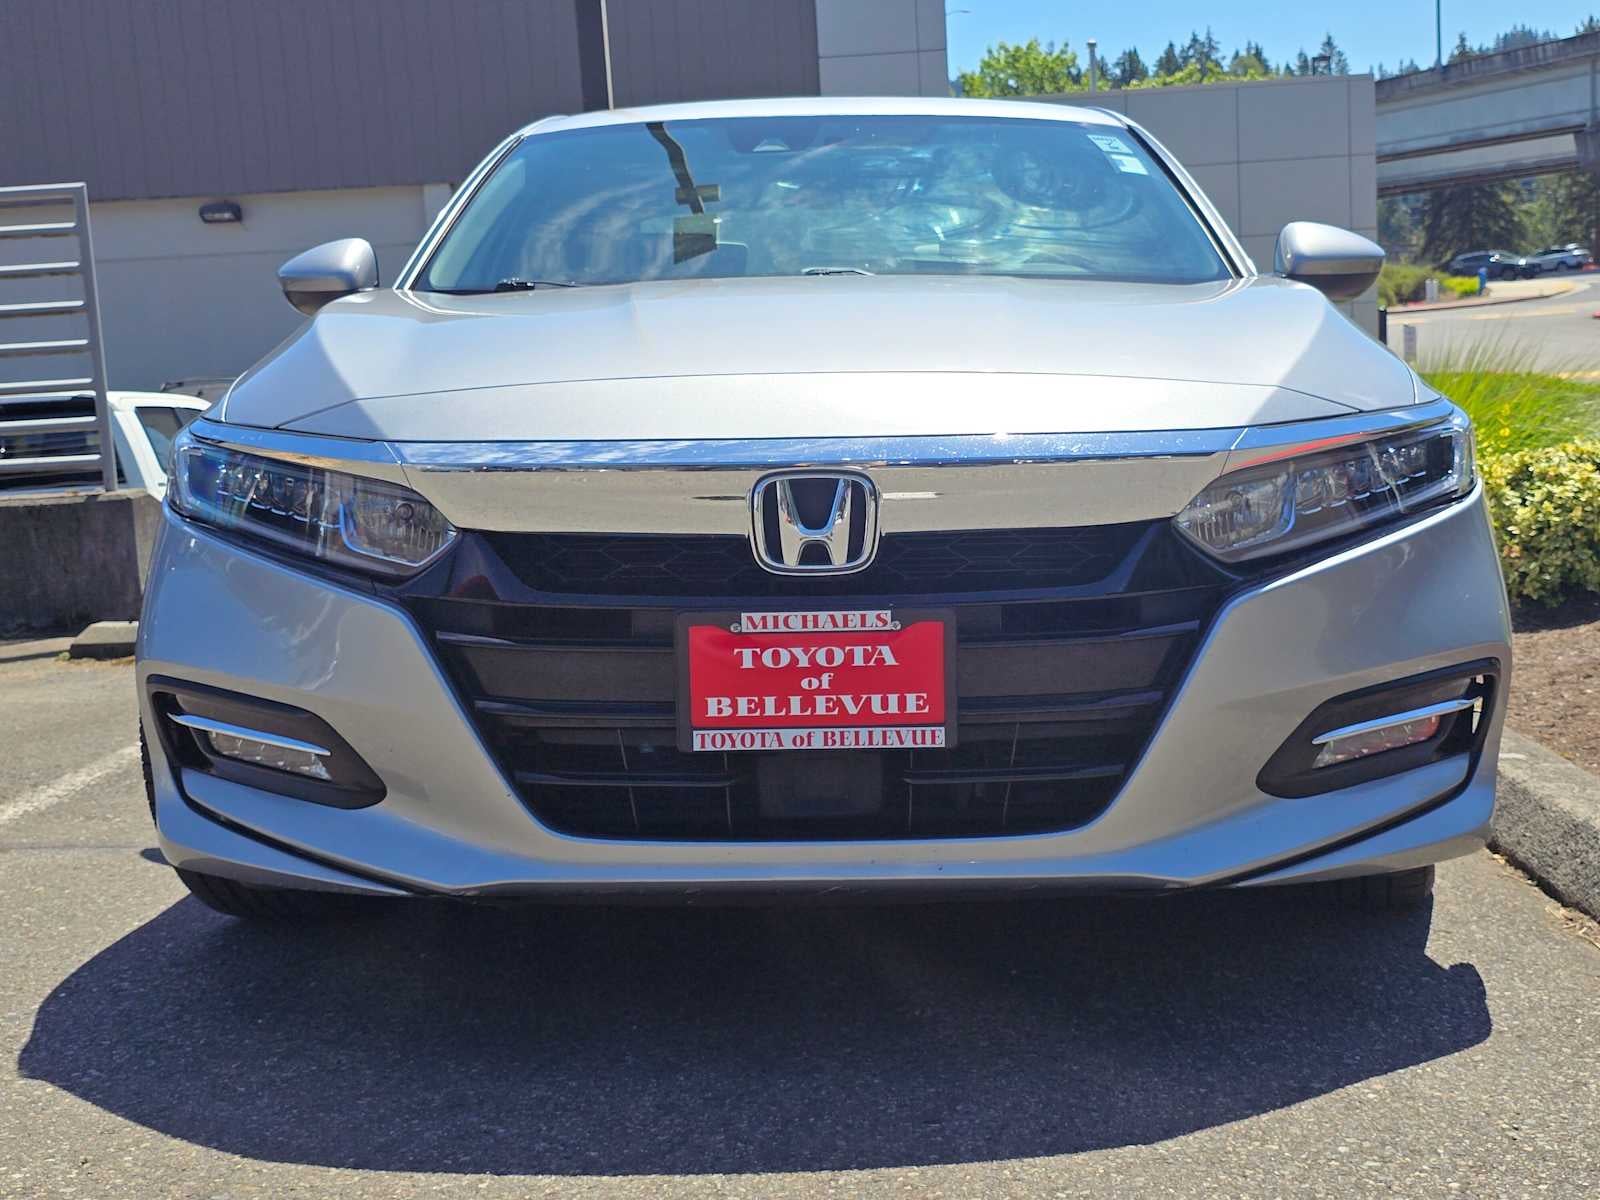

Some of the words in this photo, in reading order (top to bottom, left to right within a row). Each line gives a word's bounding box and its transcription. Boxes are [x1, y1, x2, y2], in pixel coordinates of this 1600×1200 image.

[744, 612, 890, 631] MICHAELS
[733, 645, 899, 669] TOYOTA
[800, 672, 834, 690] of
[705, 692, 930, 717] BELLEVUE
[696, 731, 785, 749] TOYOTA
[791, 731, 814, 747] of
[823, 728, 944, 747] BELLEVUE
